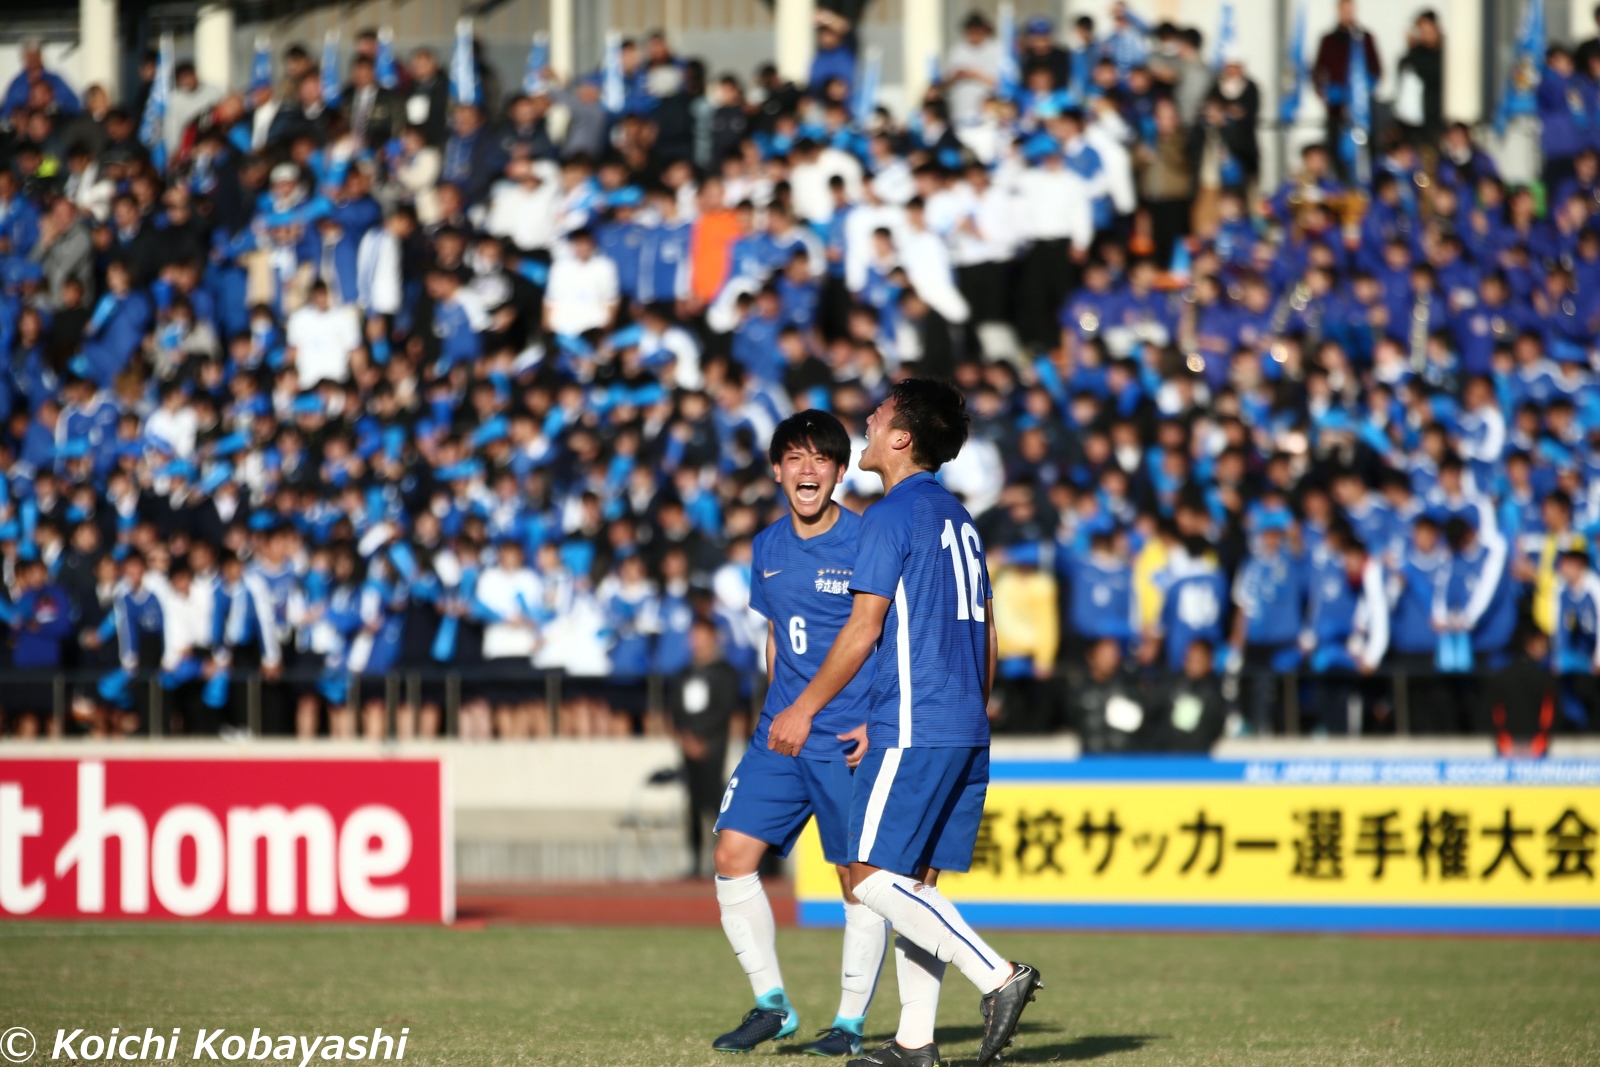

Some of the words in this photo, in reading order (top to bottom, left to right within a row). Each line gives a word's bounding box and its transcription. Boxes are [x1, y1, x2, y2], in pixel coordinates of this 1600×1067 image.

[940, 519, 985, 622] 16
[789, 616, 807, 655] 6
[720, 777, 739, 813] 6
[54, 761, 412, 918] home
